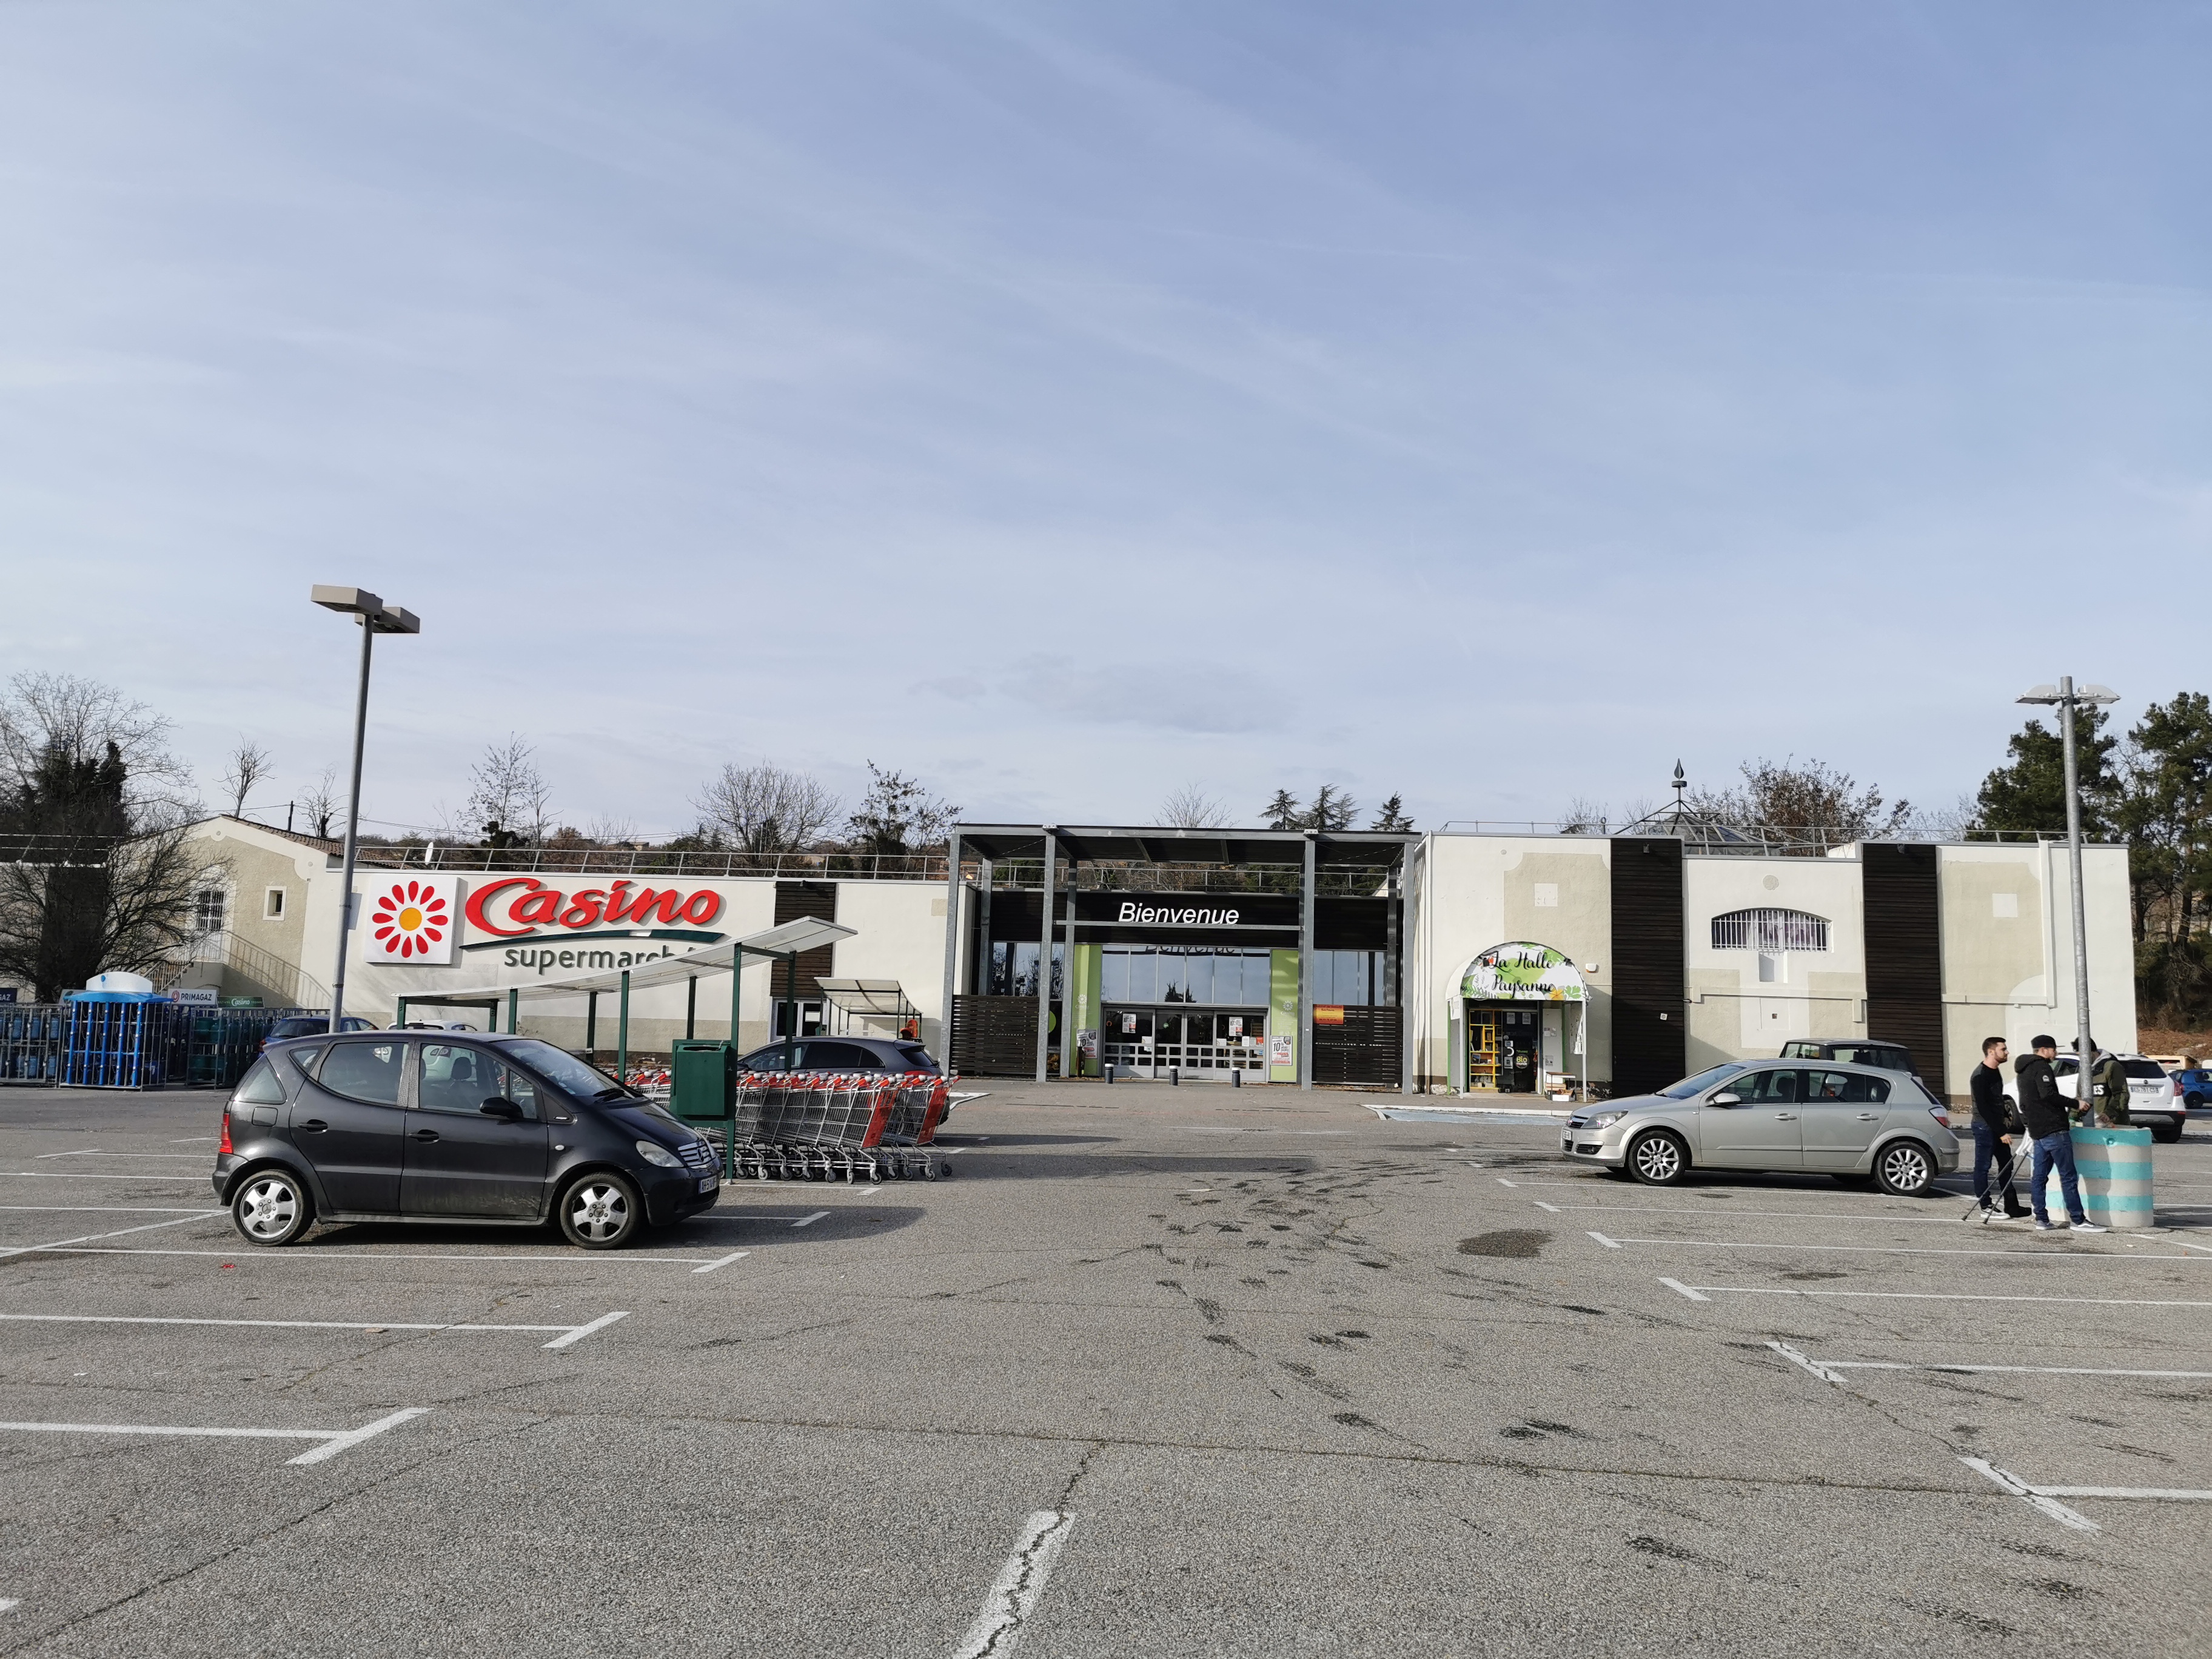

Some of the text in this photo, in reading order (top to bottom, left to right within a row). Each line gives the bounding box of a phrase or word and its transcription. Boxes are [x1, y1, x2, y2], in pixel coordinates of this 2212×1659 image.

[465, 877, 720, 935] Casino
[1118, 902, 1239, 925] Bienvenue
[1489, 950, 1556, 973] La Halle
[181, 993, 212, 1001] PRIMAGAZ
[1491, 973, 1556, 999] Paysanne
[231, 998, 250, 1007] Casino
[1273, 1042, 1281, 1051] 10
